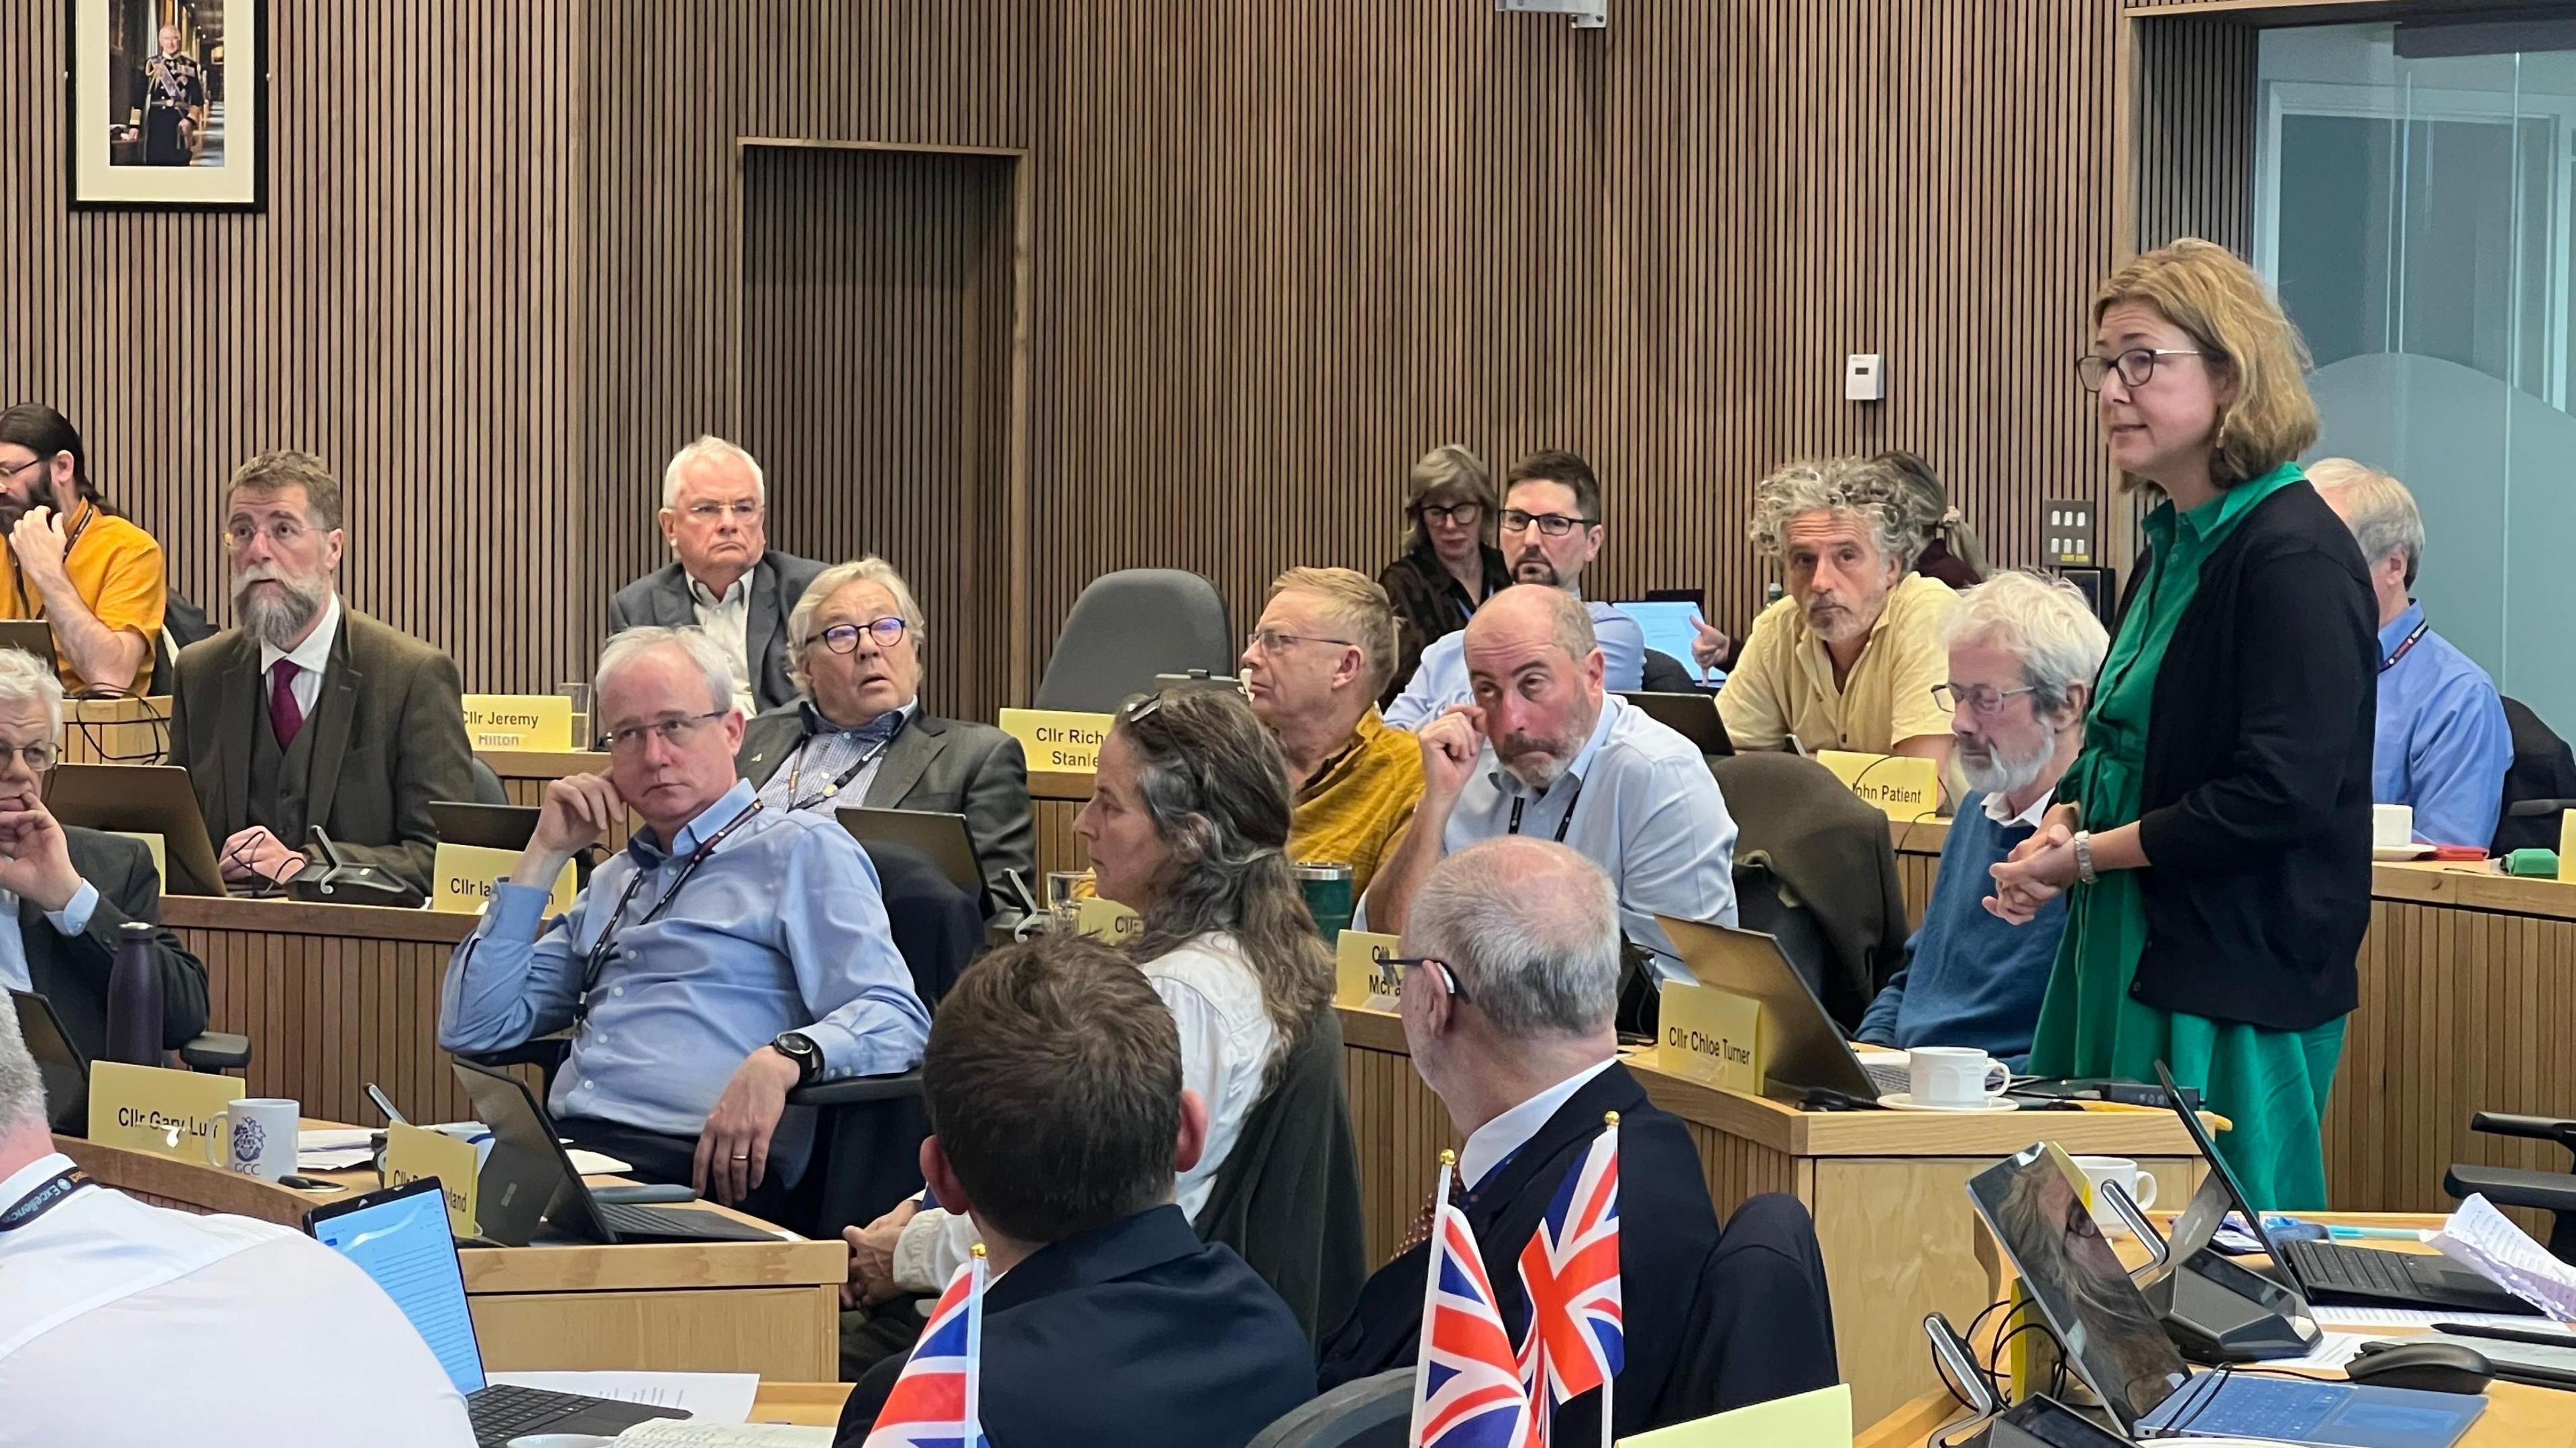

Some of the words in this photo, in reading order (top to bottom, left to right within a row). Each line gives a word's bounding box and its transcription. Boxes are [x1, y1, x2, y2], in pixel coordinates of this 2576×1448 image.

[488, 711, 539, 729] Jeremy
[1036, 727, 1064, 742] Cllr
[1069, 729, 1104, 745] Rich
[1052, 750, 1098, 768] Stanle
[1882, 785, 1921, 804] Patient
[450, 877, 476, 895] Cllr
[479, 881, 491, 897] Ia
[1669, 1027, 1688, 1050] Cllr
[1691, 1031, 1720, 1057] Chloe
[1722, 1038, 1750, 1066] Turner
[118, 1107, 146, 1127] Cllr
[235, 1162, 262, 1176] GCC
